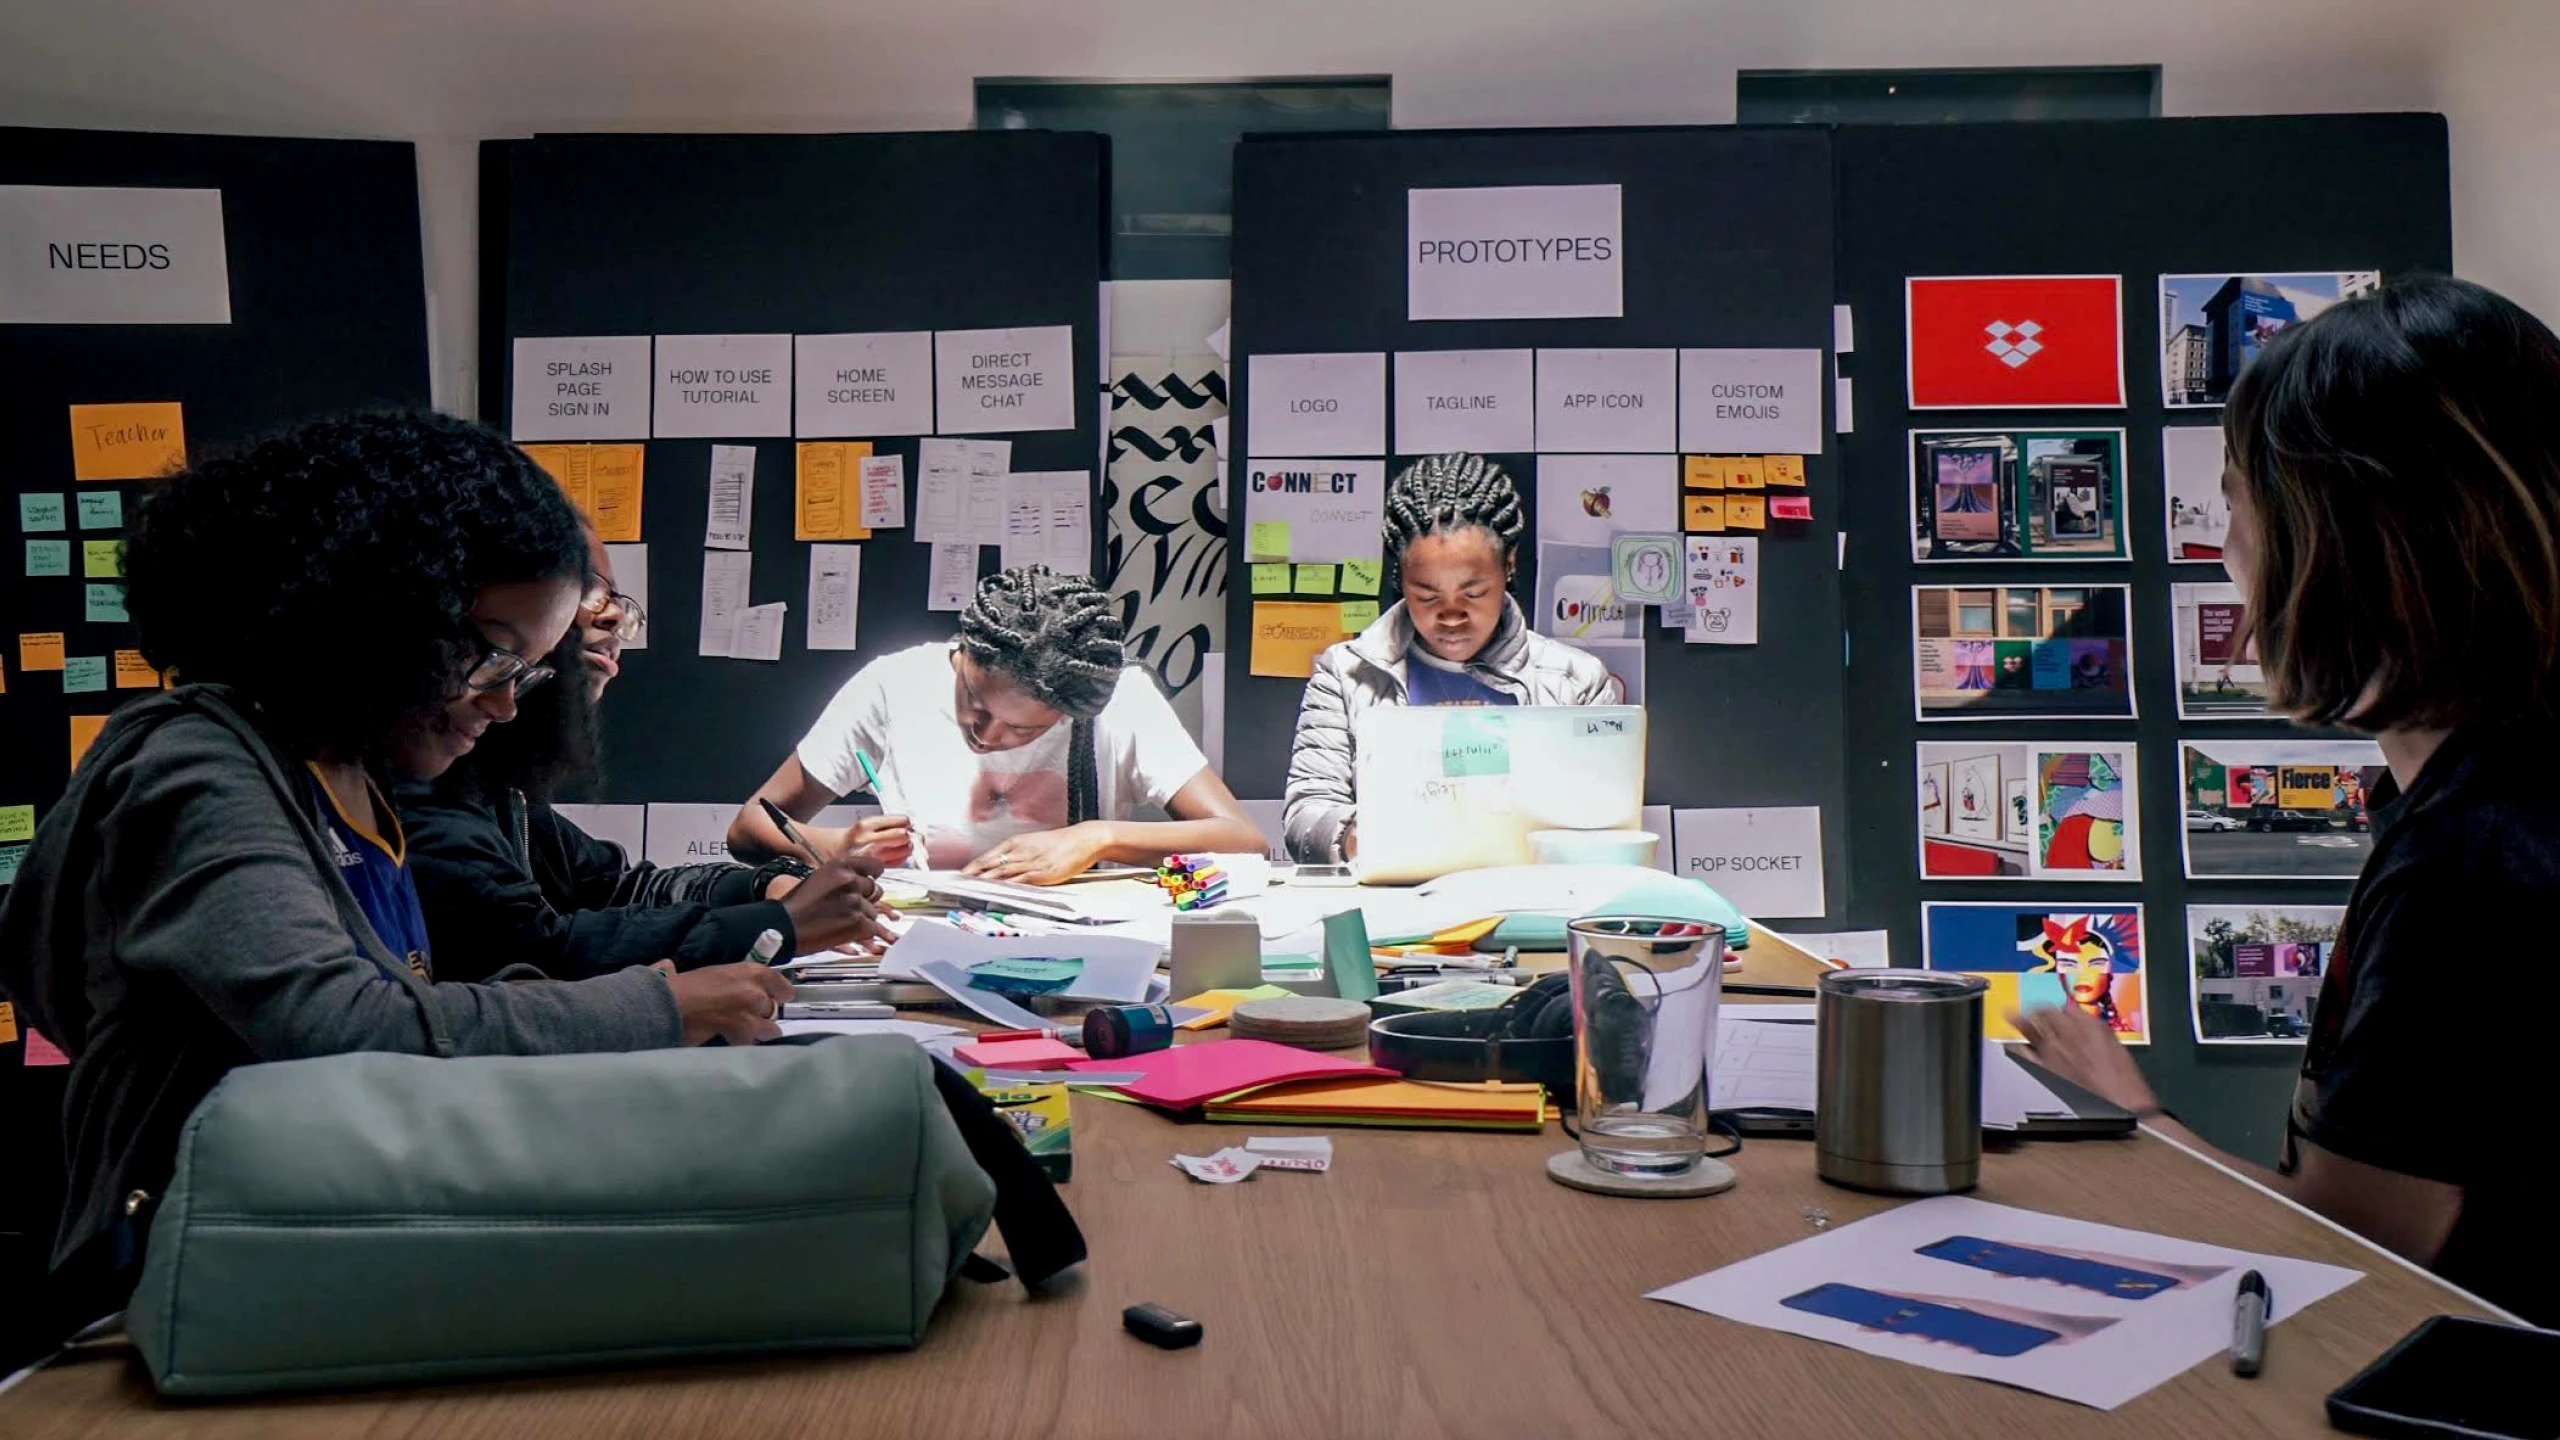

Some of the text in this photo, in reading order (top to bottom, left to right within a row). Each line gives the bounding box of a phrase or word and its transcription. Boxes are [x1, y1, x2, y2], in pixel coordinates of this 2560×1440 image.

[49, 243, 170, 269] NEEDS
[1419, 237, 1612, 263] PROTOTYPES
[972, 353, 1032, 369] DIRECT
[547, 362, 612, 376] SPLASH
[836, 369, 886, 383] HOME
[670, 370, 772, 385] HOW TO USE
[961, 373, 1043, 389] MESSAGE
[557, 382, 602, 396] PAGE
[827, 388, 895, 403] SCREEN
[1711, 384, 1784, 399] CUSTOM
[682, 390, 759, 404] TUTORIAL
[981, 393, 1025, 408] CHAT
[1427, 396, 1497, 410] TAGLINE
[1563, 394, 1643, 408] APP ICON
[548, 402, 610, 416] SIGN IN
[1290, 399, 1338, 413] LOGO
[1716, 404, 1780, 419] EMOJIS
[85, 423, 168, 451] Teacher
[2282, 768, 2330, 790] Fierce
[687, 840, 730, 855] ALER
[1690, 855, 1803, 872] POP SOCKET
